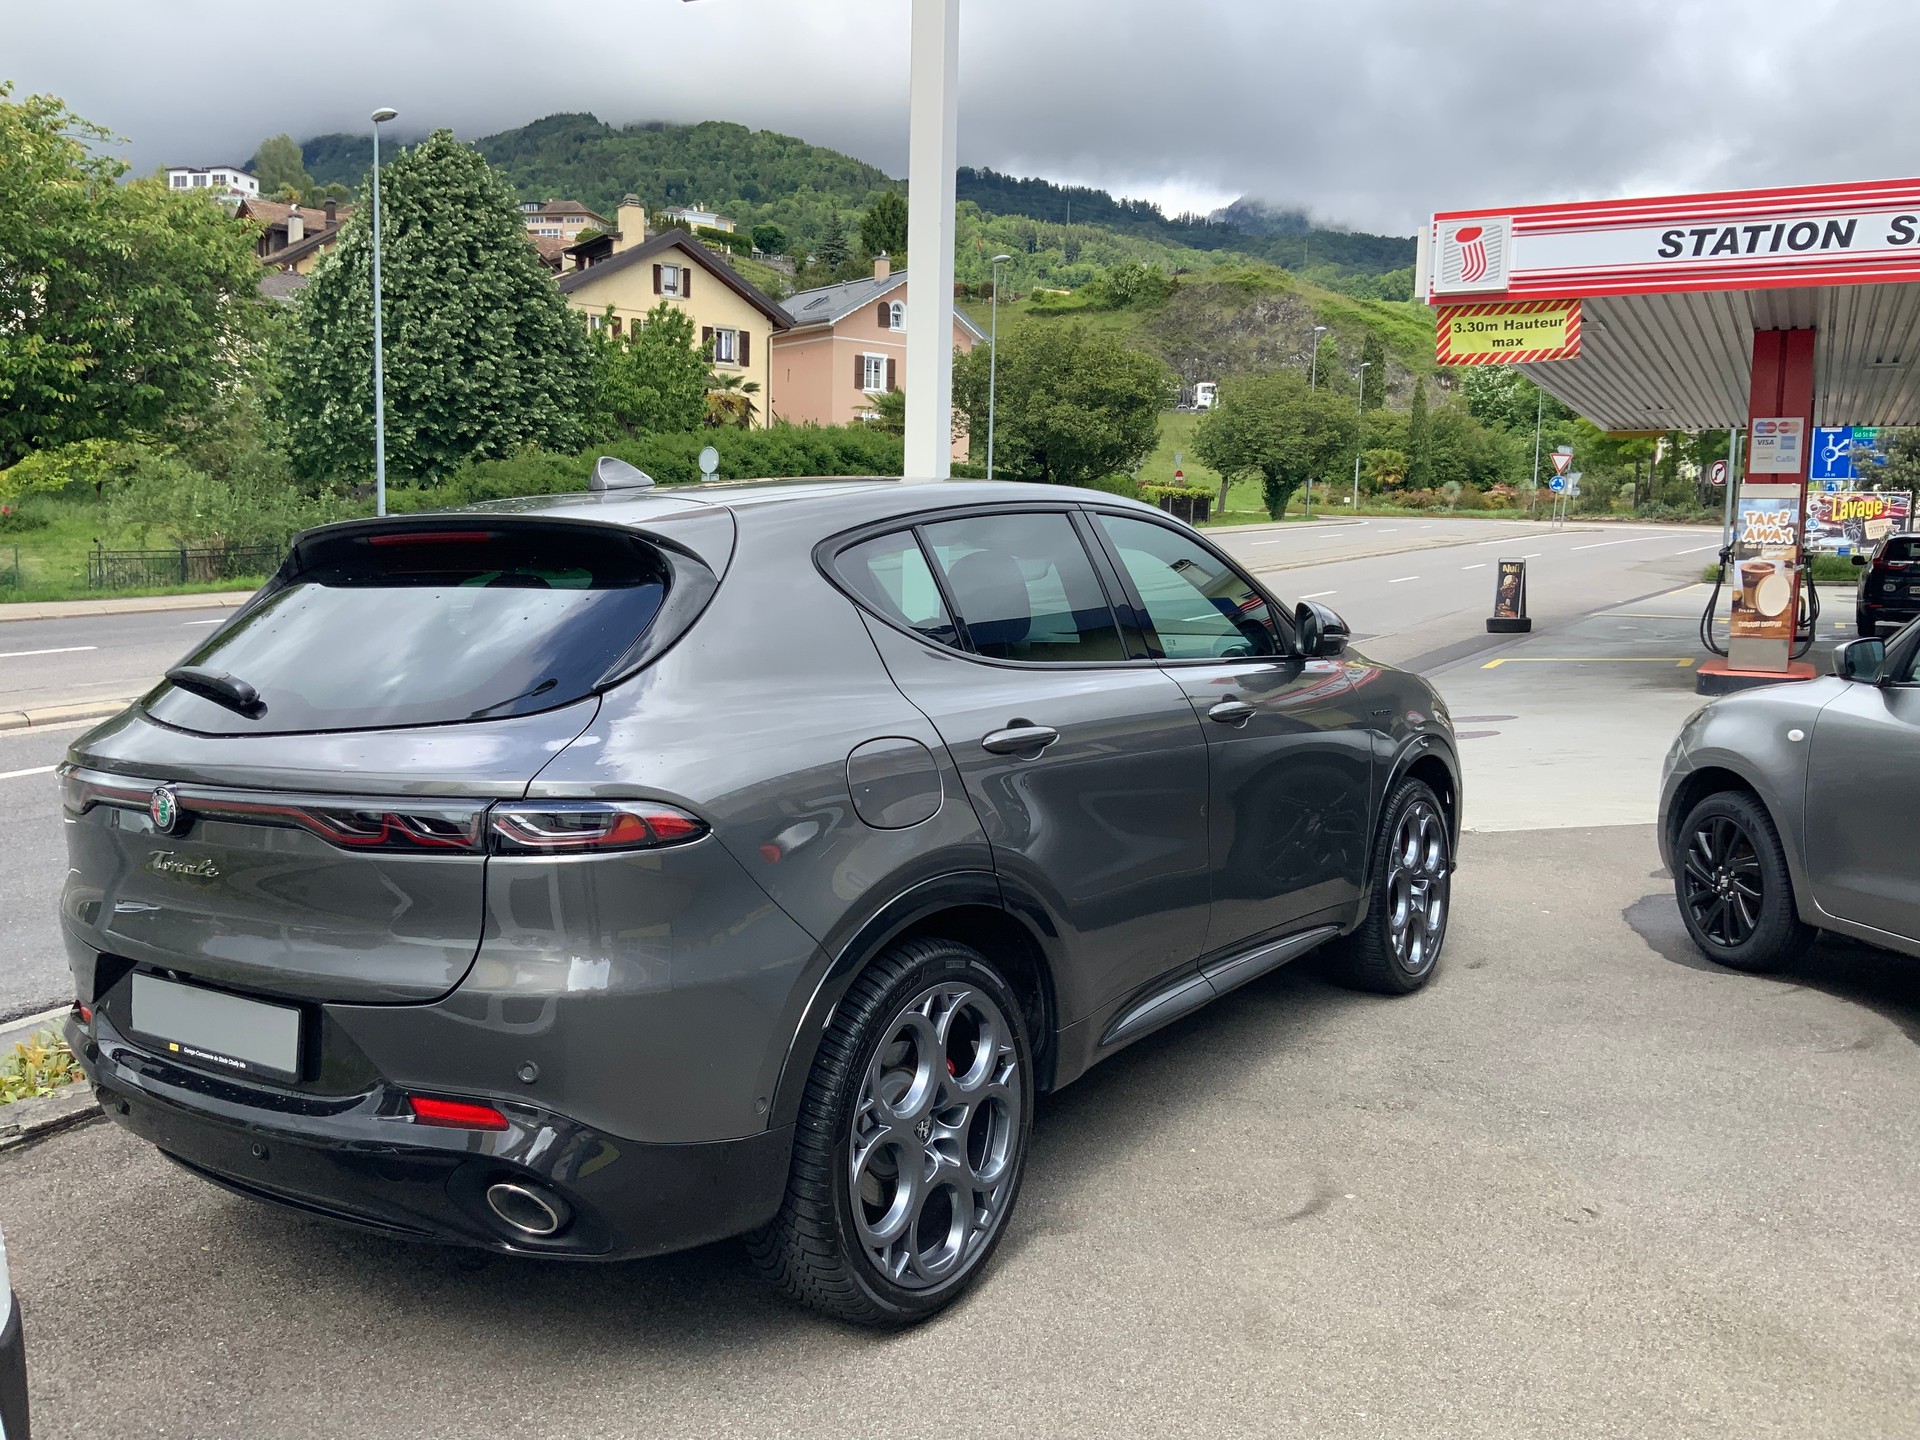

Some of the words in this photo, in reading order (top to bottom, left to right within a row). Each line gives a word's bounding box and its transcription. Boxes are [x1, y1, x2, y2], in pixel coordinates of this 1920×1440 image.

[1657, 218, 1858, 259] STATION
[1886, 214, 1920, 246] S
[1453, 320, 1498, 333] 3.30m
[1503, 318, 1565, 331] Hauteur
[1492, 337, 1524, 347] max
[1831, 497, 1884, 522] Lavage
[1744, 510, 1790, 526] TAKE
[1743, 528, 1793, 543] AWAY
[147, 849, 220, 878] Tonale
